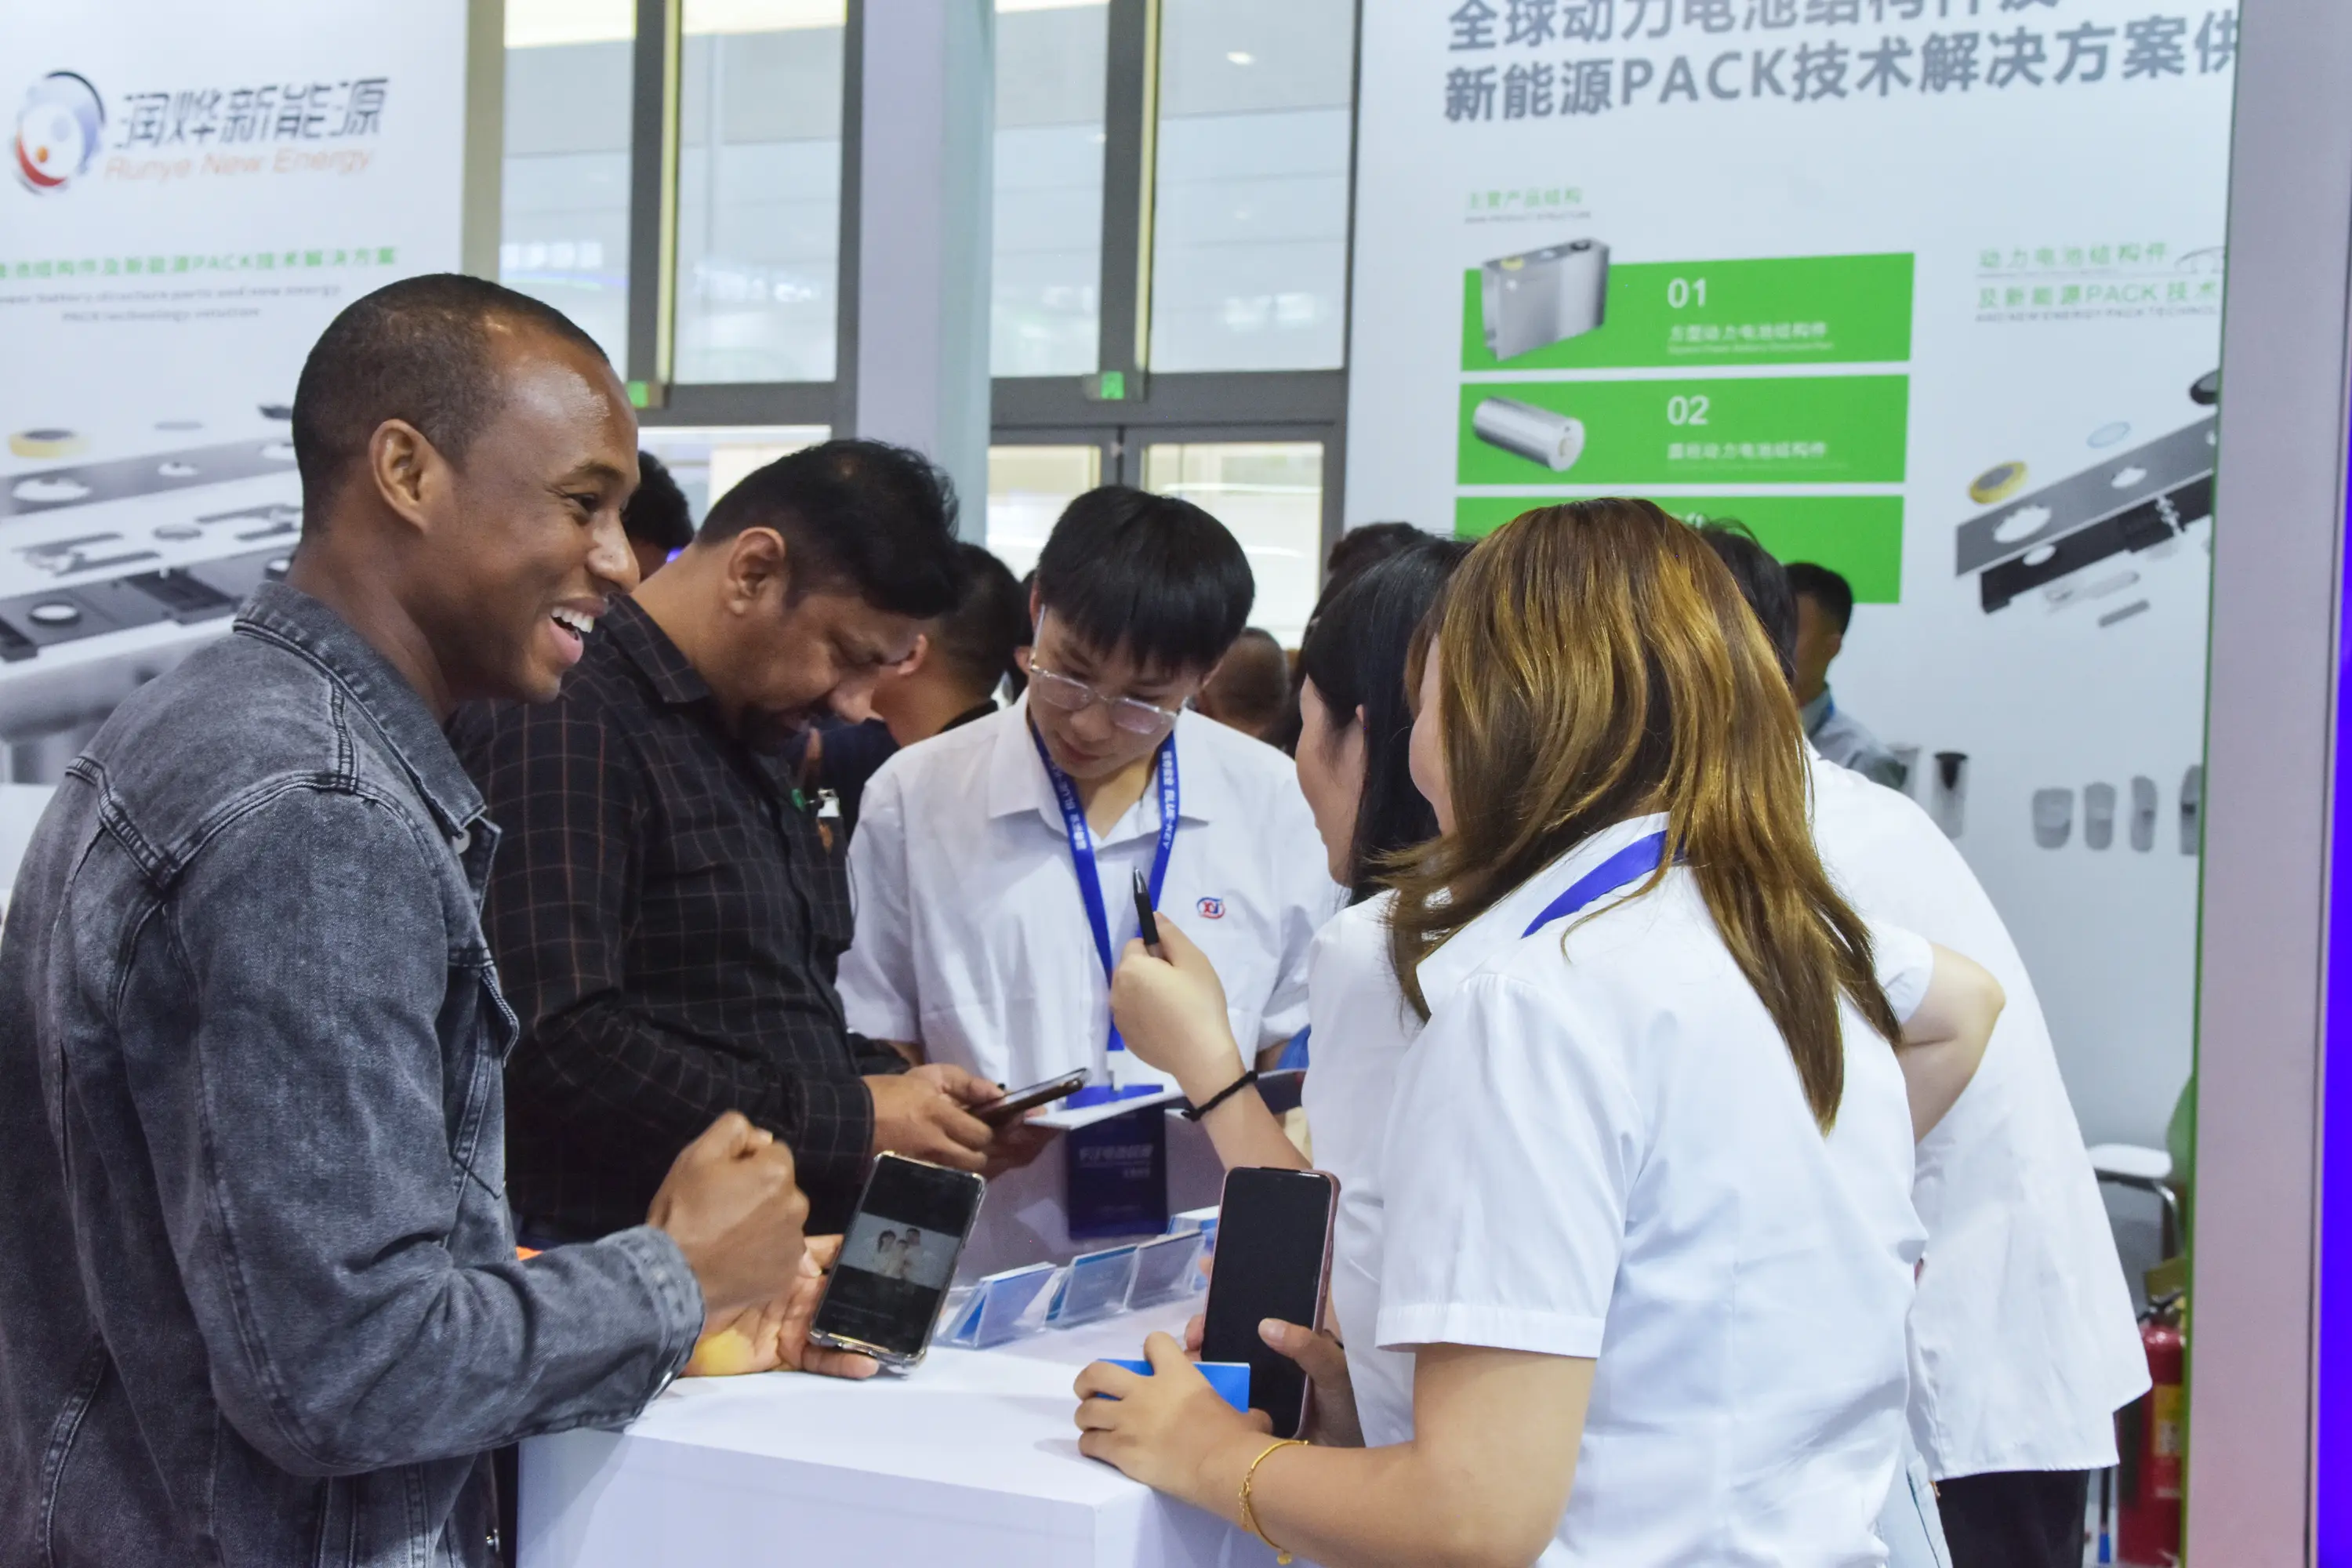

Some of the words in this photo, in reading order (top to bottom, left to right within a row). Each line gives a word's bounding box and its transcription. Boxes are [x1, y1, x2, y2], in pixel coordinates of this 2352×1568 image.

[1448, 0, 2060, 52] 全球动力电池
[1444, 9, 2238, 122] 新能源PACK技术解决方案供
[114, 76, 389, 149] 润烨新能源
[104, 155, 191, 183] Runye
[201, 151, 260, 176] New
[273, 147, 371, 176] Energy
[1667, 277, 1708, 309] 01
[1666, 395, 1710, 426] 02
